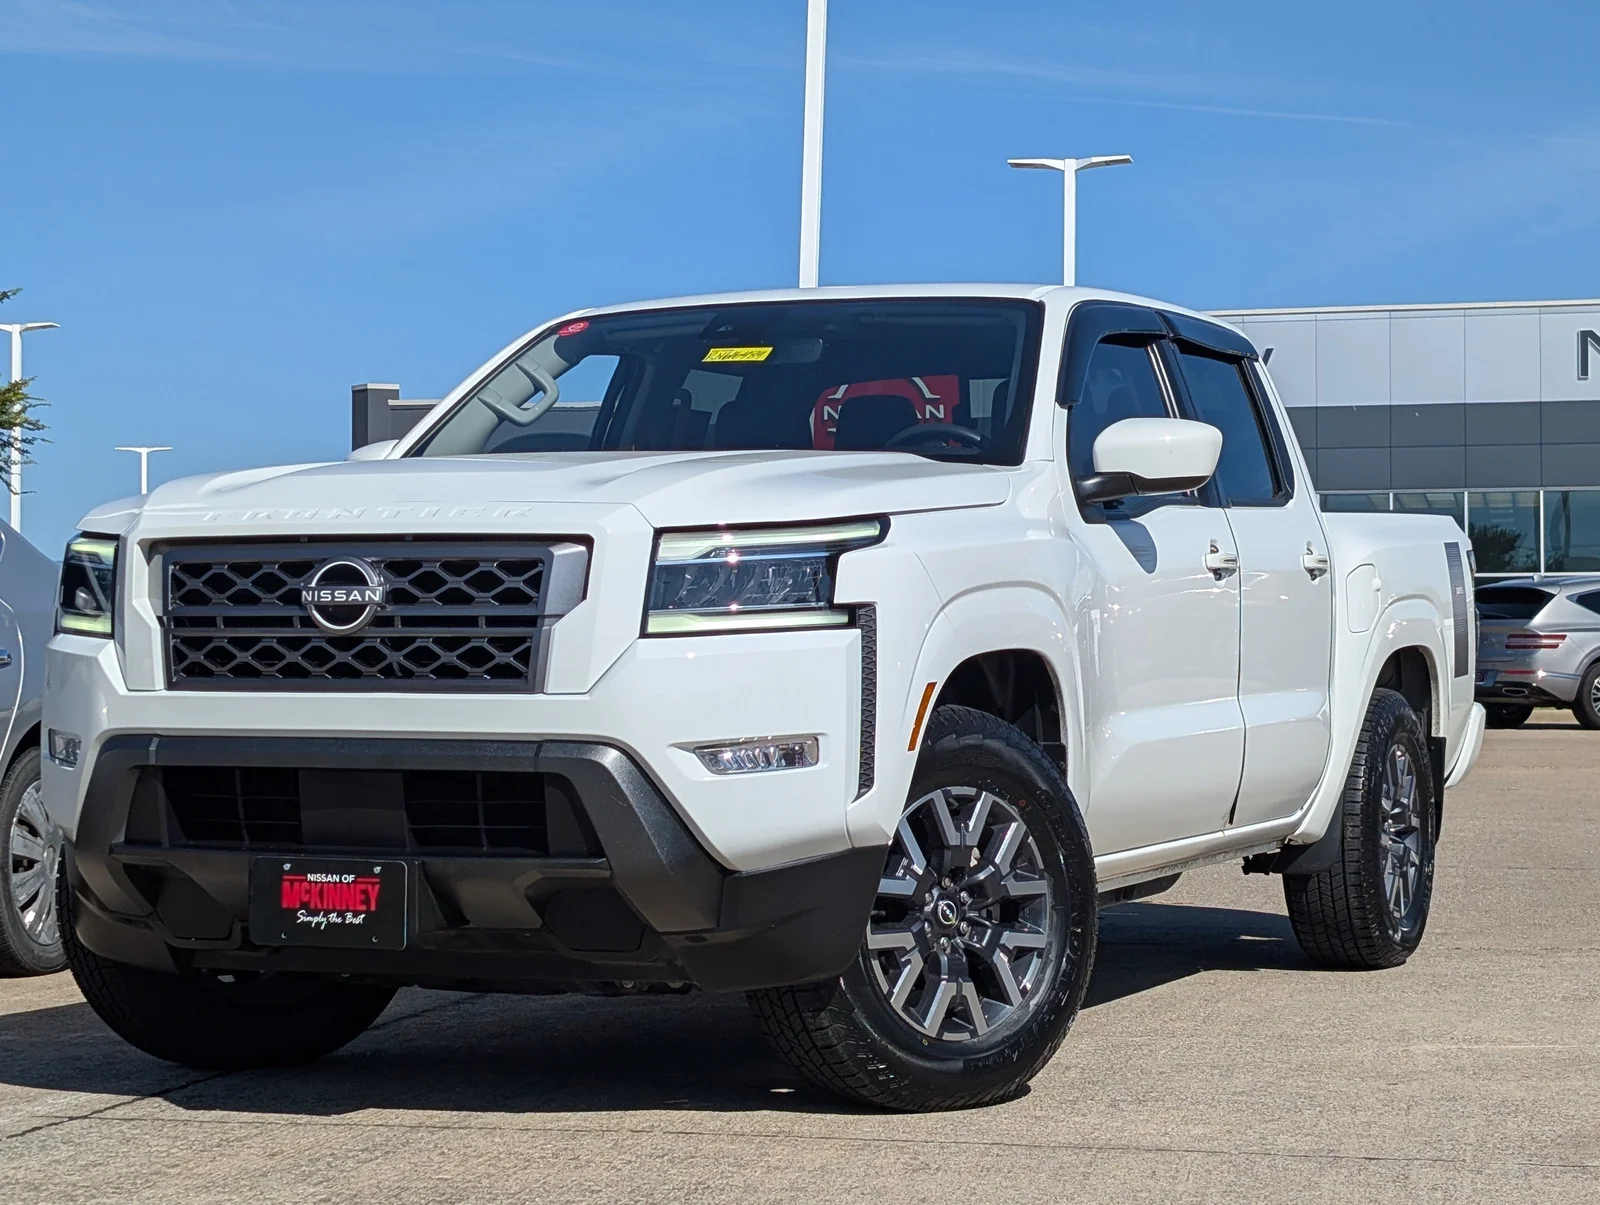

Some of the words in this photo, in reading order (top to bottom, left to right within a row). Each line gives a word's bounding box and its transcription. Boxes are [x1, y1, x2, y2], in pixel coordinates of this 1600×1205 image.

[301, 590, 380, 601] NISSAN
[306, 873, 340, 883] NISSAN
[341, 874, 356, 883] OF
[296, 909, 328, 930] Simply
[328, 911, 343, 924] the
[345, 912, 366, 924] Best
